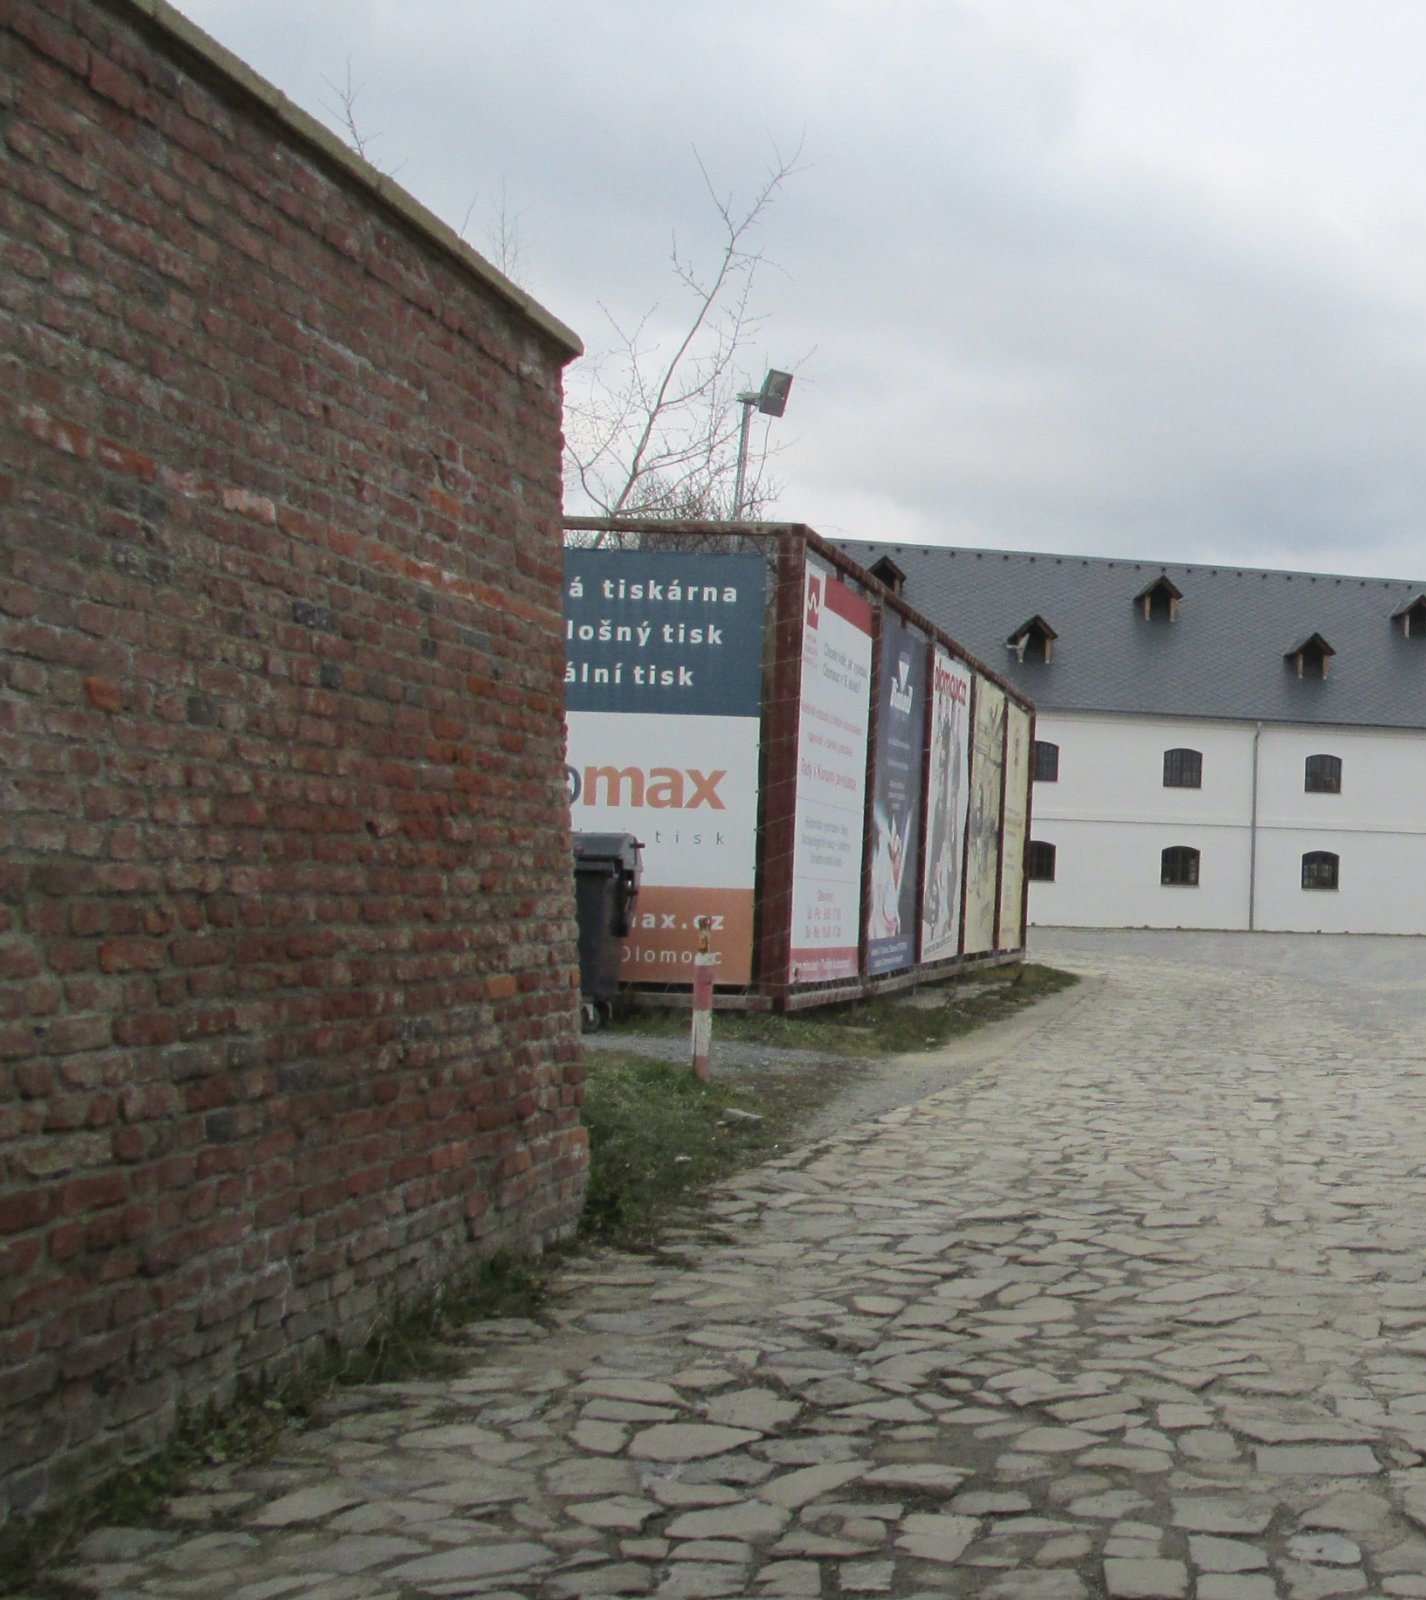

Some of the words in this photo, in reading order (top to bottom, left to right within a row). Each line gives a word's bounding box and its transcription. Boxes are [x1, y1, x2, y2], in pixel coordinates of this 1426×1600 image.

[569, 576, 584, 598] á
[603, 579, 737, 603] tiskárna
[567, 619, 651, 647] lošný
[663, 624, 723, 645] tisk
[564, 661, 623, 684] ální
[634, 665, 694, 686] tisk
[655, 831, 724, 845] tisk
